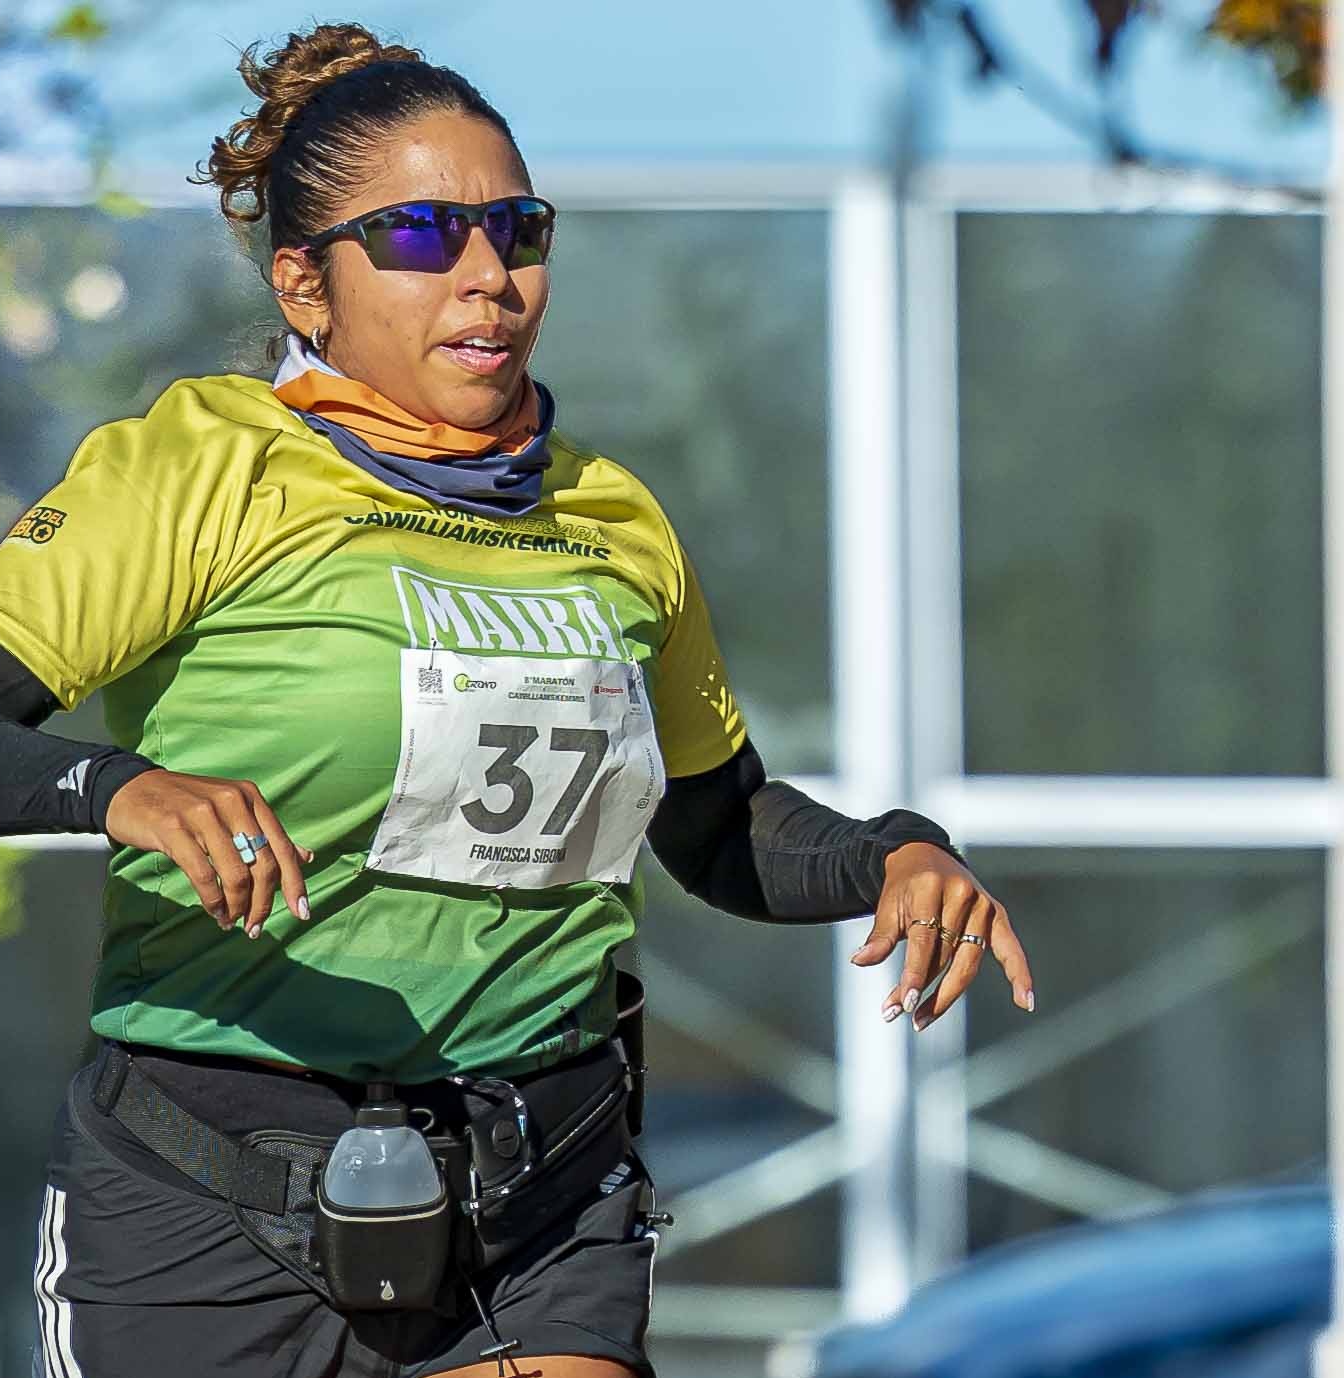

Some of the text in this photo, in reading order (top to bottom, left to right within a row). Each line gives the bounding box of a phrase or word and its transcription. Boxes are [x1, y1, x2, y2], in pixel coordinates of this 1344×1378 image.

[410, 578, 622, 660] MAIRA
[459, 723, 609, 836] 37
[469, 844, 531, 862] FRANCISCA
